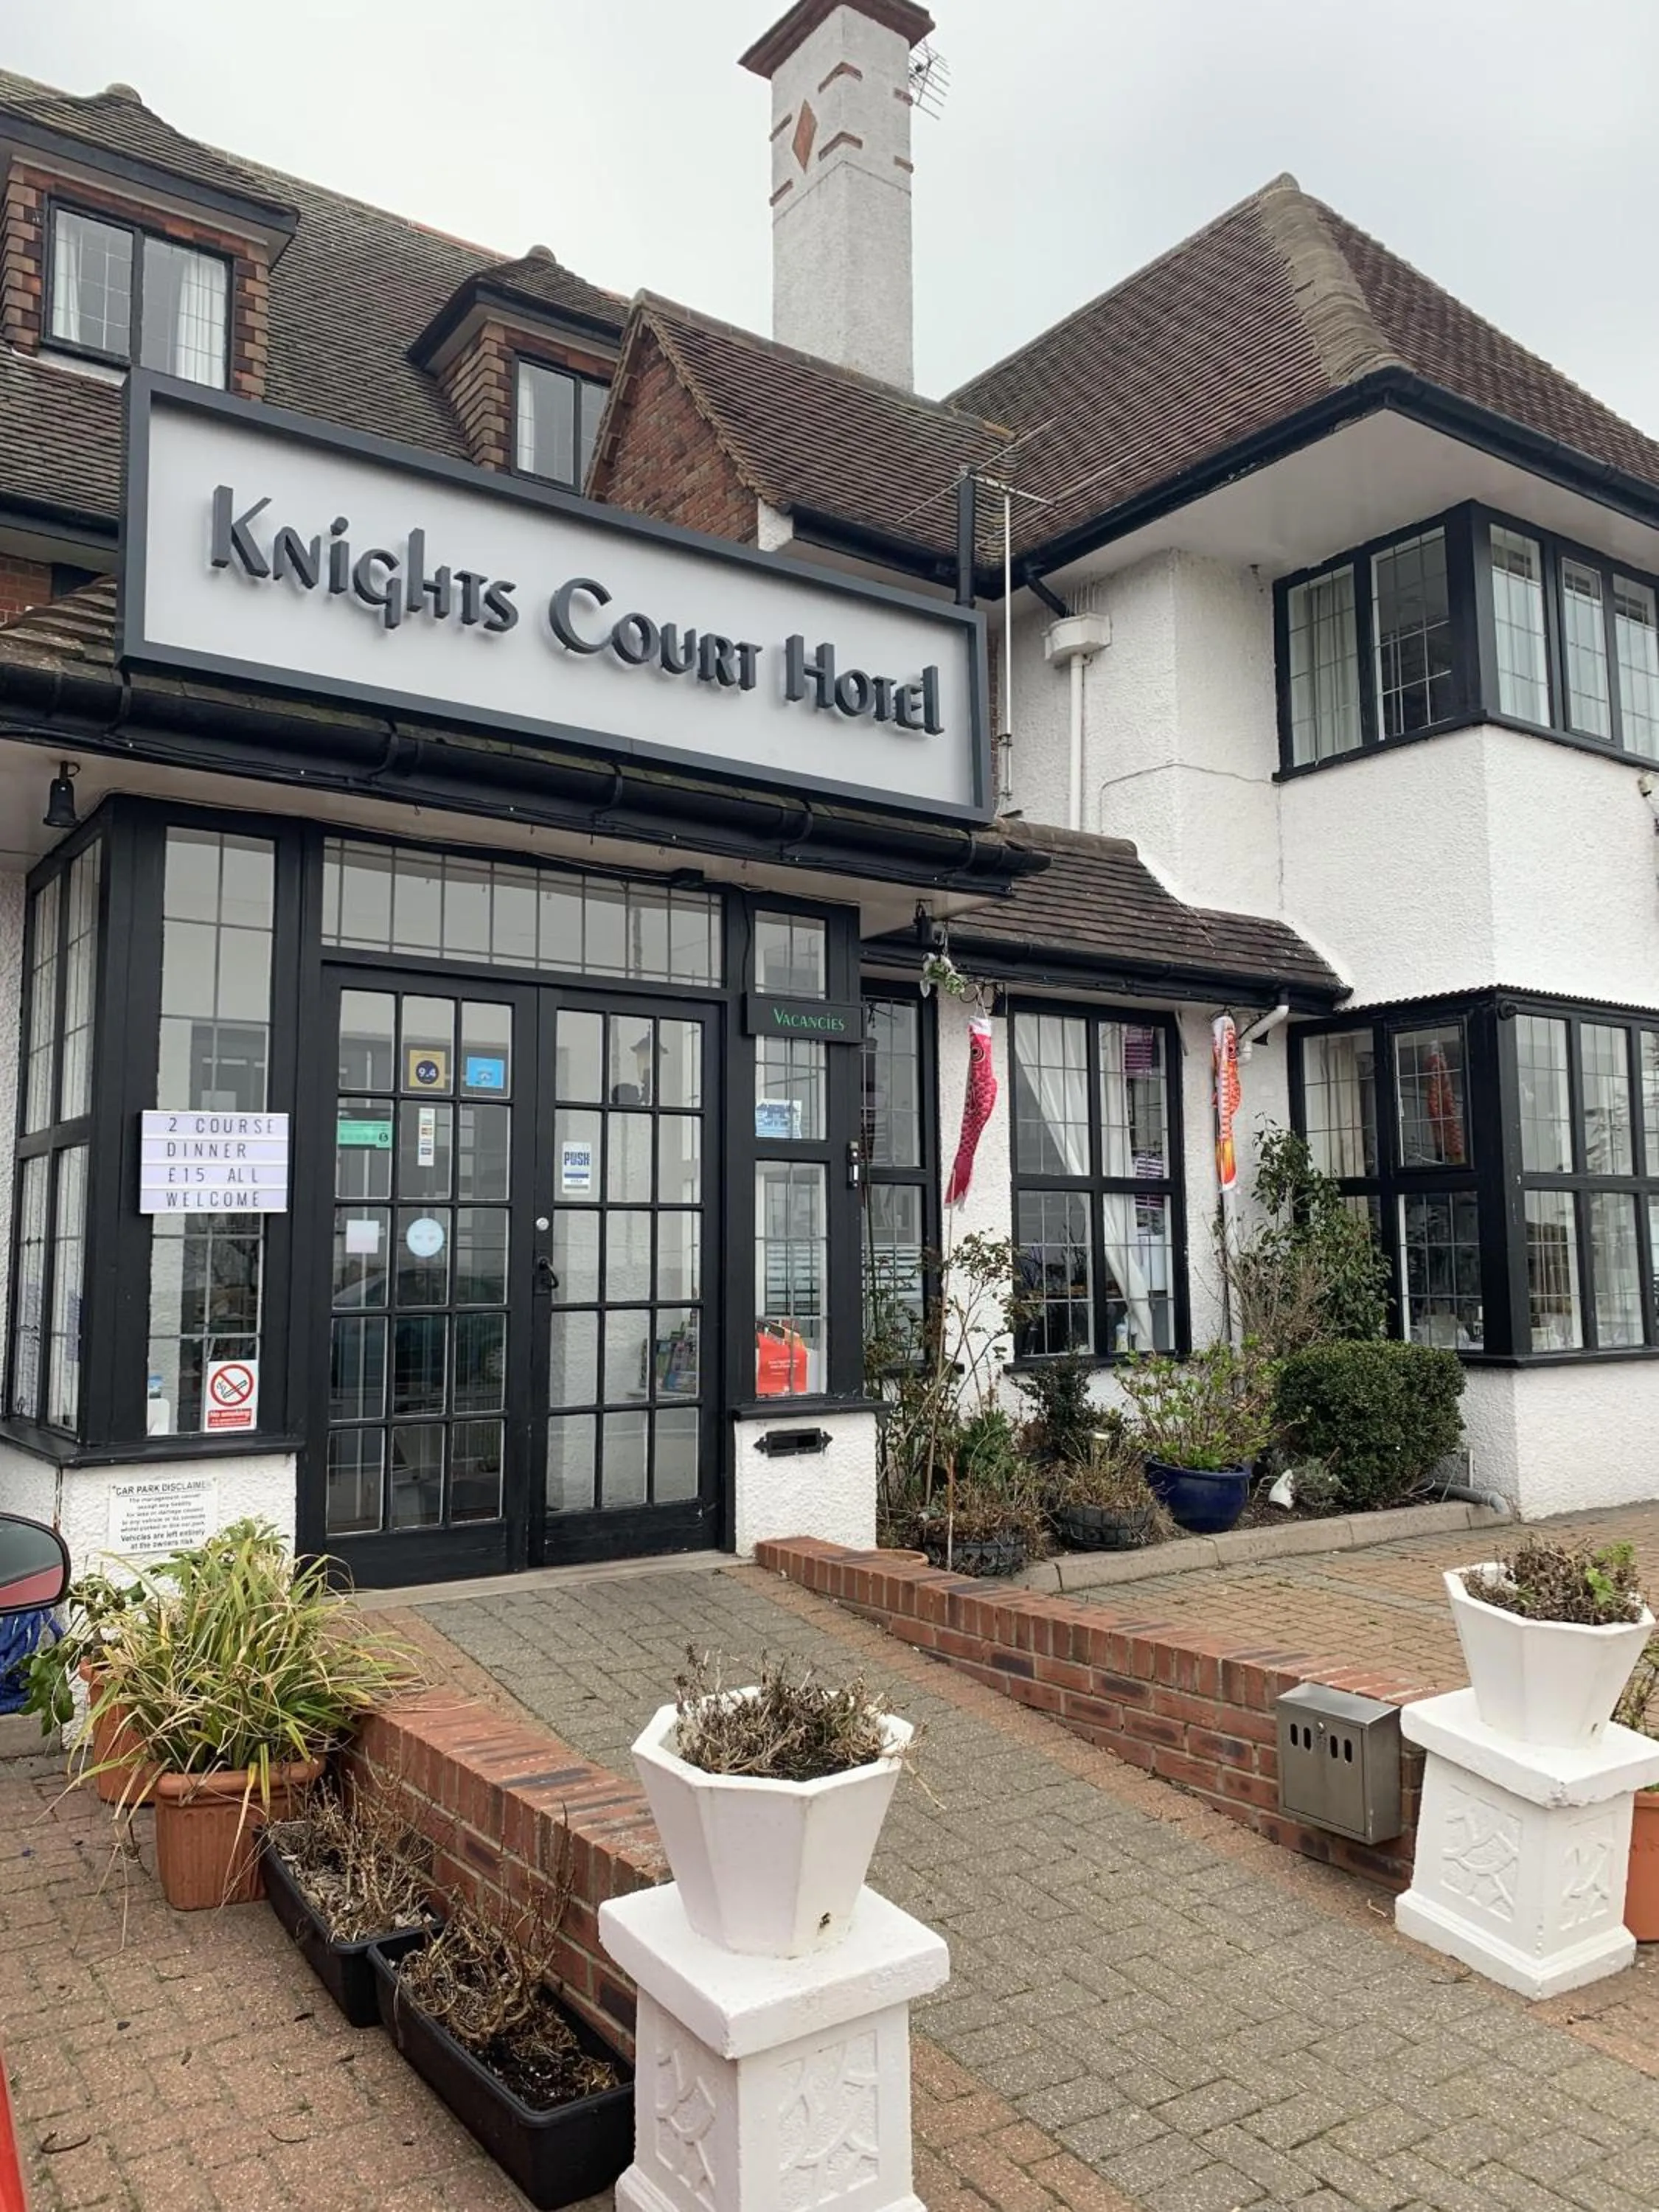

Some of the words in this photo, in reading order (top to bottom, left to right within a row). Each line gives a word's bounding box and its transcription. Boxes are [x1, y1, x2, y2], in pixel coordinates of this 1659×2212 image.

[418, 1067, 437, 1077] 9.4
[168, 1117, 178, 1133] 2
[195, 1117, 274, 1134] COURSE
[167, 1141, 246, 1158] DINNER
[564, 1151, 590, 1166] PUSH
[227, 1167, 259, 1183] ALL
[166, 1191, 260, 1207] WELCOME
[116, 1486, 135, 1496] CAR
[136, 1484, 160, 1493] PARK
[161, 1481, 210, 1492] DISCLAIM
